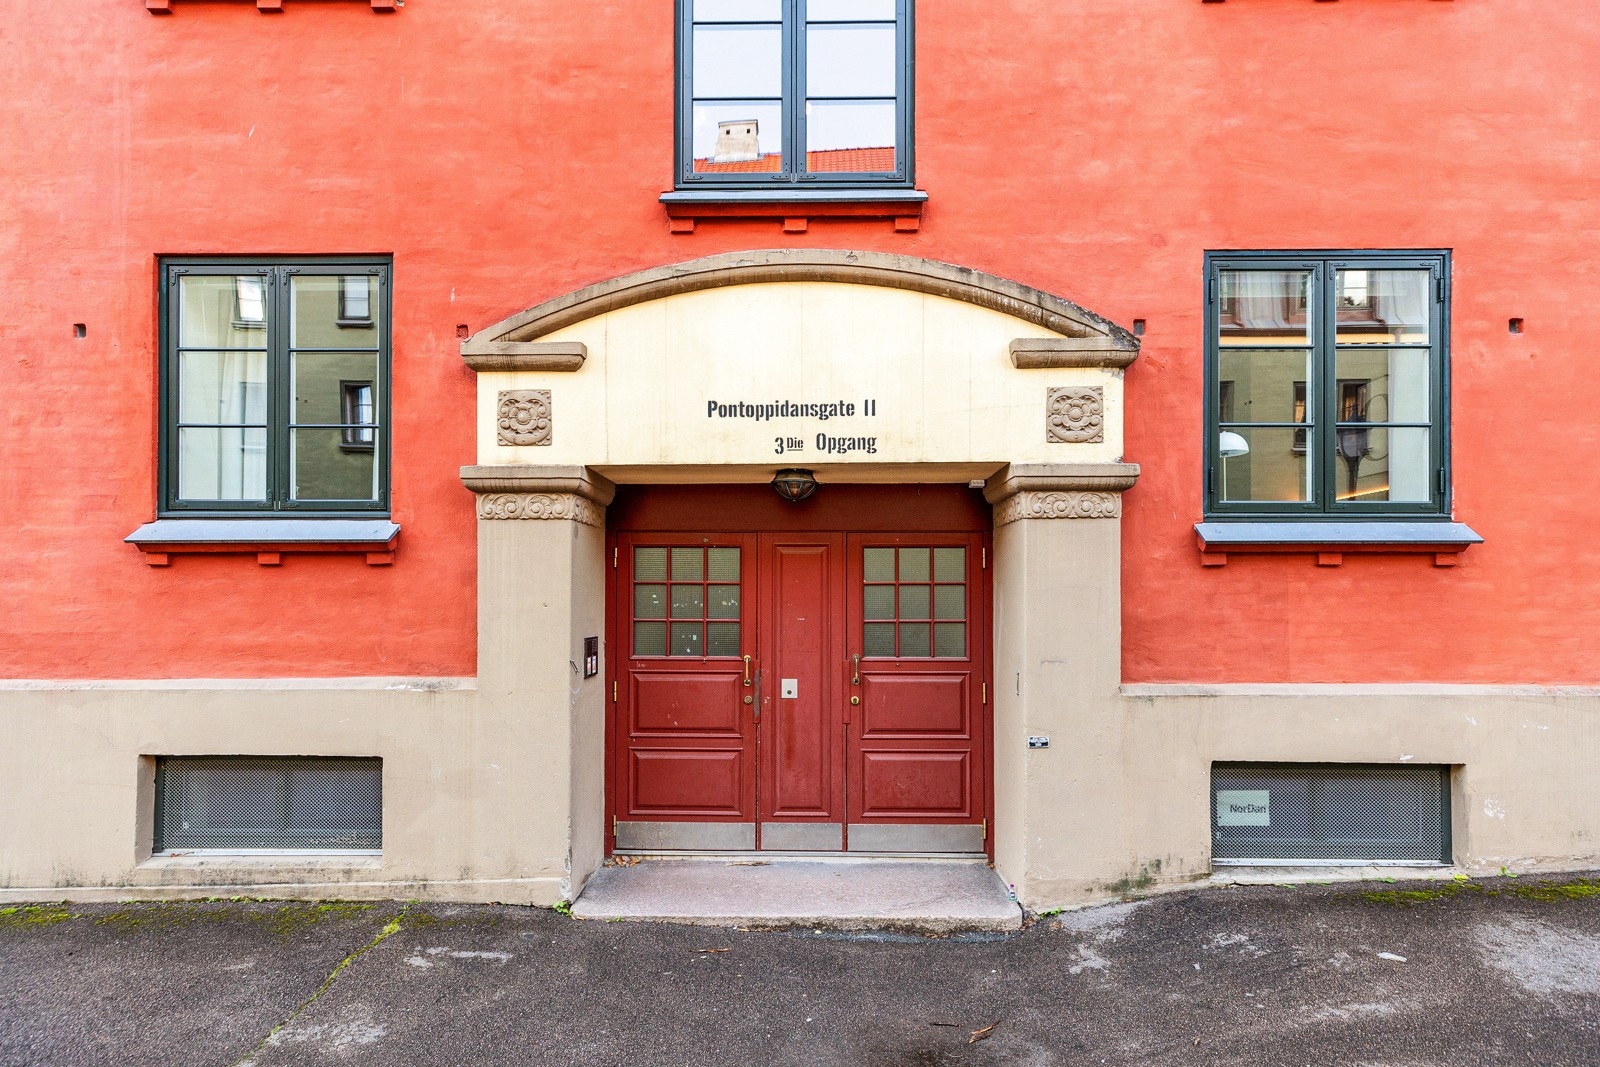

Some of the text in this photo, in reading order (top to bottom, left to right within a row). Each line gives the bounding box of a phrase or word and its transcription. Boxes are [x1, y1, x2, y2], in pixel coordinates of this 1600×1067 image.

[707, 400, 855, 421] Pontoppidansgate
[816, 433, 877, 454] Opgang
[1230, 804, 1267, 813] NorDan
